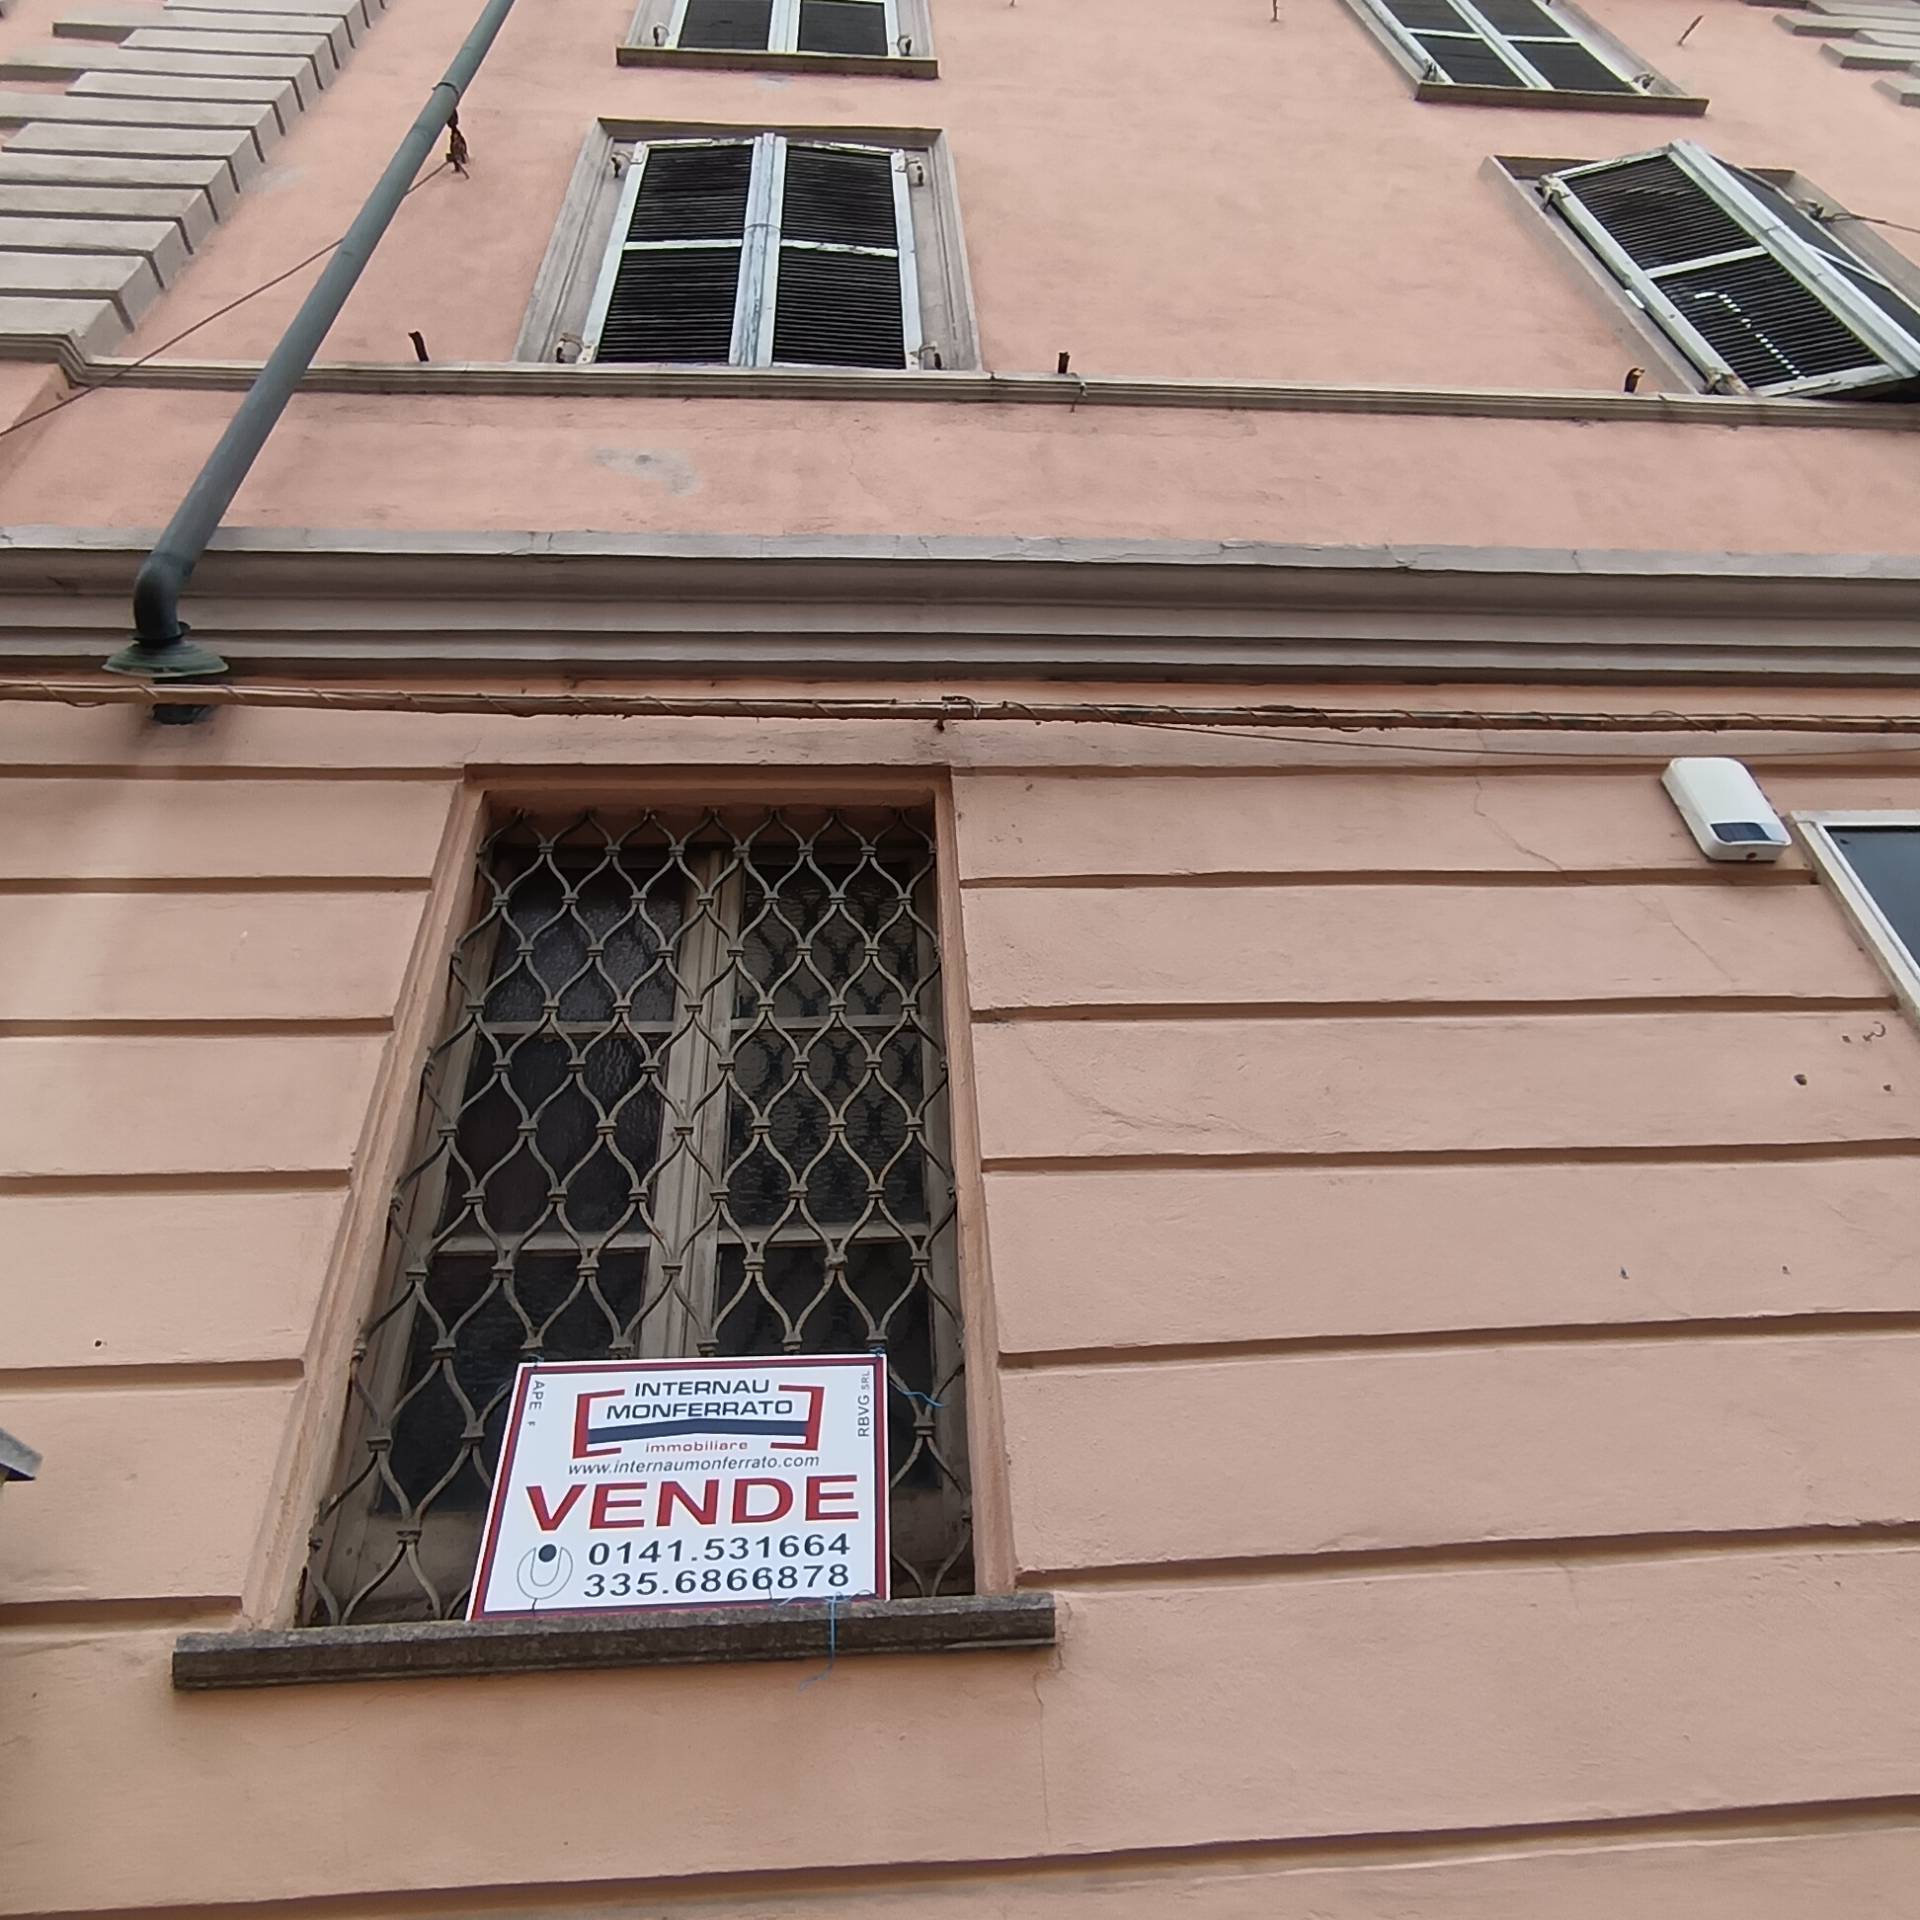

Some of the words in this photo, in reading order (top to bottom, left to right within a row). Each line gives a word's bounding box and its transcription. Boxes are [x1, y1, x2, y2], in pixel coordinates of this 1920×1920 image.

[529, 1380, 545, 1411] APE
[634, 1379, 771, 1397] INTERNAU
[606, 1399, 794, 1420] MONFERRATO
[857, 1394, 870, 1437] RBVG
[645, 1440, 749, 1454] immobiliare
[568, 1454, 820, 1476] www.internaumonferrato.com
[526, 1474, 860, 1532] VENDE
[588, 1533, 851, 1566] 0141.531664
[583, 1563, 850, 1598] 335.6866878
